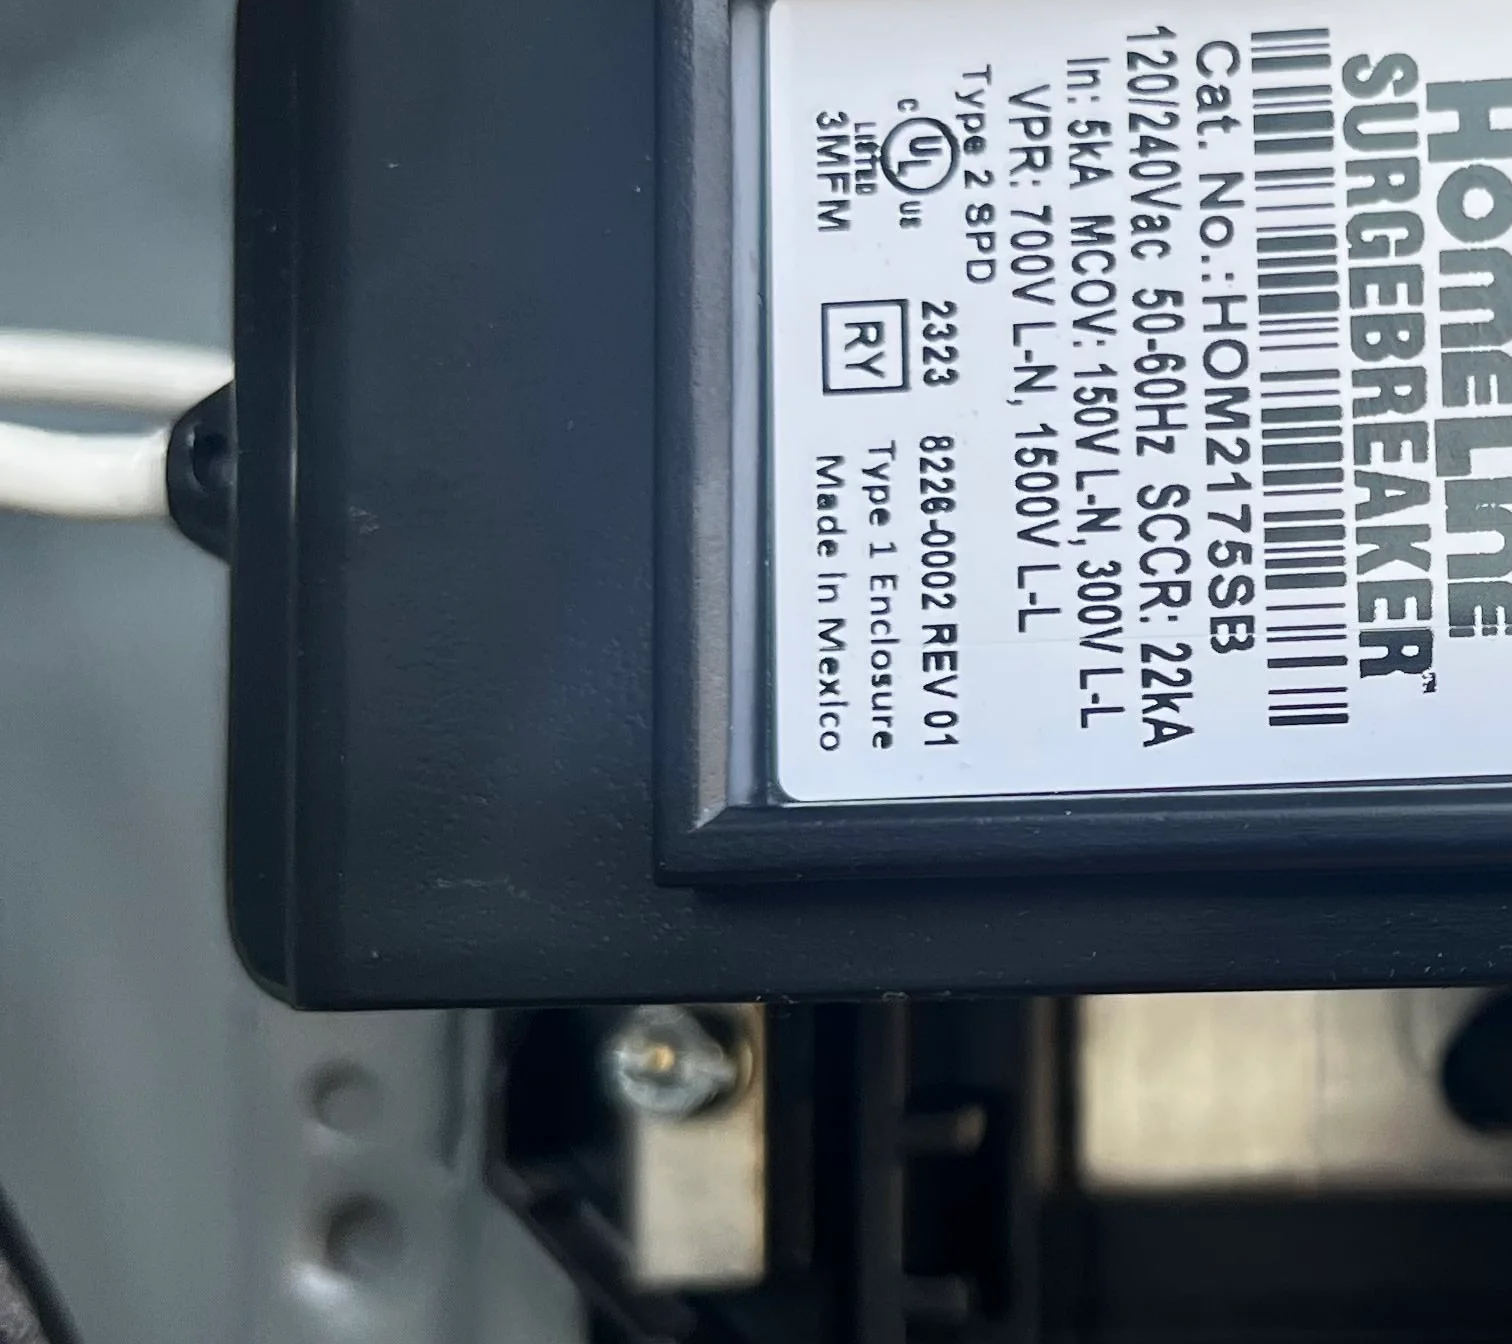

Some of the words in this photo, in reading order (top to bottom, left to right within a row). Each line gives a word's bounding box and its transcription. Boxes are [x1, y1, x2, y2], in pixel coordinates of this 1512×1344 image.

[955, 64, 993, 158] Type
[1067, 57, 1111, 104] In:
[1196, 40, 1242, 150] Cat.
[817, 111, 851, 233] 3MFM
[854, 122, 877, 196] LISTED
[964, 170, 996, 189] 2
[1008, 84, 1054, 187] VPR:
[1067, 119, 1115, 191] 5kA
[1127, 24, 1182, 261] 120/240Vac
[965, 203, 997, 286] SPD
[1010, 206, 1056, 306] 700V
[1070, 215, 1118, 348] MCOV:
[844, 321, 886, 379] RY
[922, 300, 959, 387] 2323
[1006, 322, 1058, 406] L-N,
[1132, 288, 1188, 457] 50-60Hz
[1341, 54, 1435, 679] SURGEBREAKER
[1073, 363, 1121, 456] 150V
[817, 456, 847, 557] Made
[862, 440, 897, 526] Type
[920, 436, 957, 610] 8226-0002
[1014, 423, 1061, 548] 1500V
[1068, 470, 1122, 546] L-N,
[869, 542, 898, 559] 1
[1137, 484, 1192, 624] SCCR:
[1017, 564, 1062, 633] L-L
[1076, 560, 1124, 654] 300V
[818, 618, 850, 752] Mexico
[869, 574, 900, 750] Enclosure
[921, 623, 959, 698] REV
[1079, 667, 1126, 729] L-L
[1140, 642, 1194, 748] 22kA
[923, 711, 960, 746] 01
